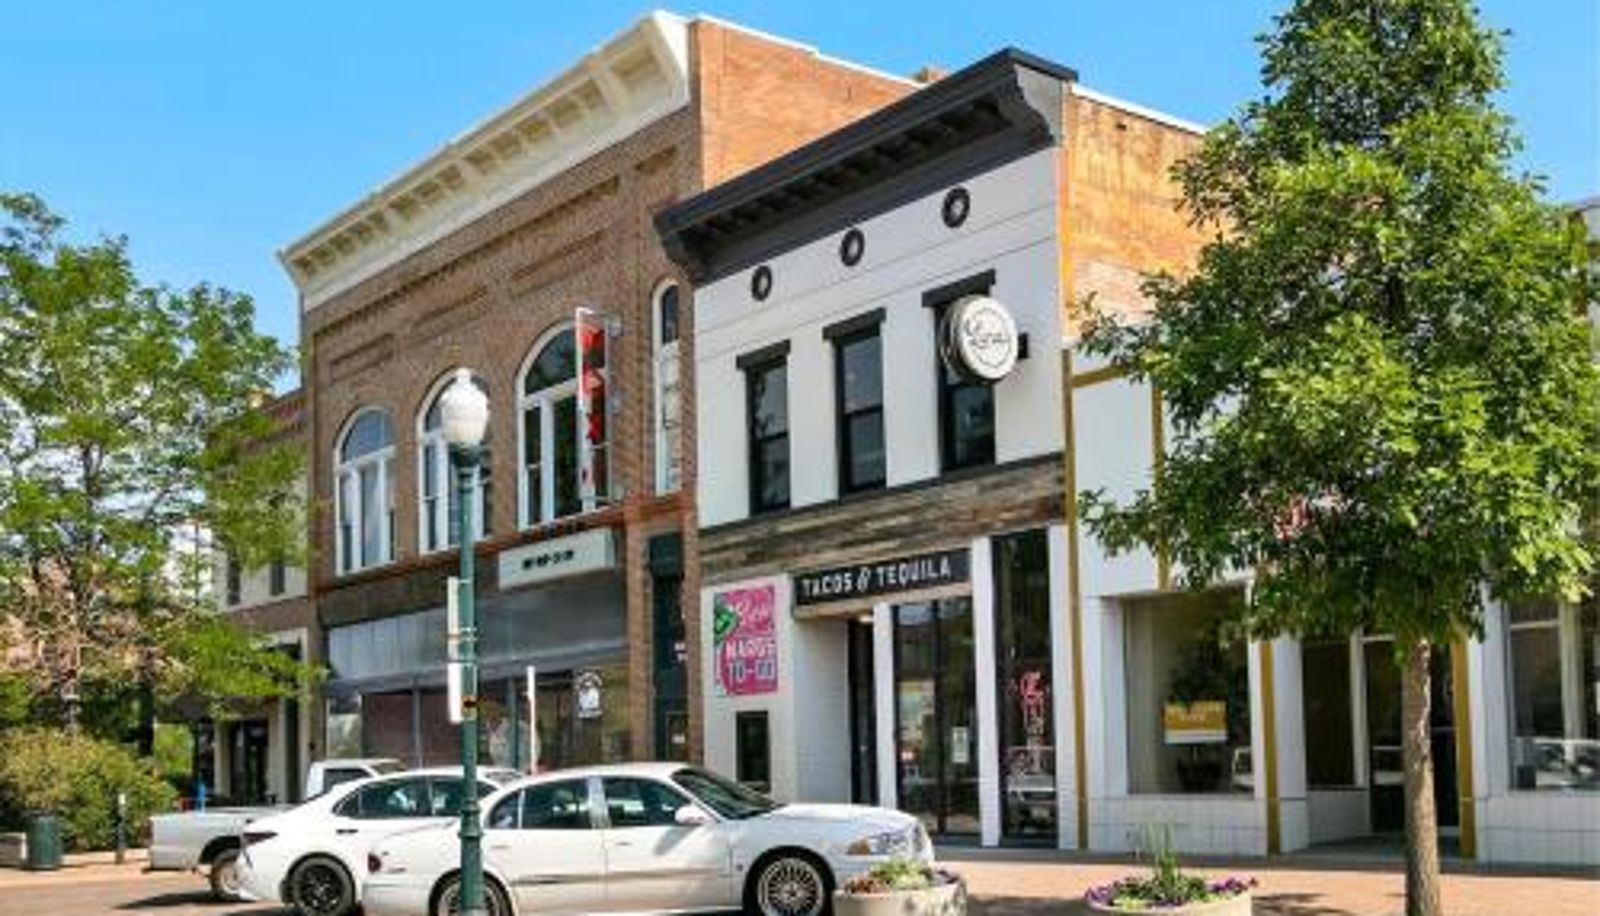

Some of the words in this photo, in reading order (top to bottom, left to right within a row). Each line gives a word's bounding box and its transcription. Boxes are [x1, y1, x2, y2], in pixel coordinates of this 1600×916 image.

[801, 573, 853, 597] TACOS
[856, 565, 872, 593] &
[875, 555, 951, 587] TEQUILA
